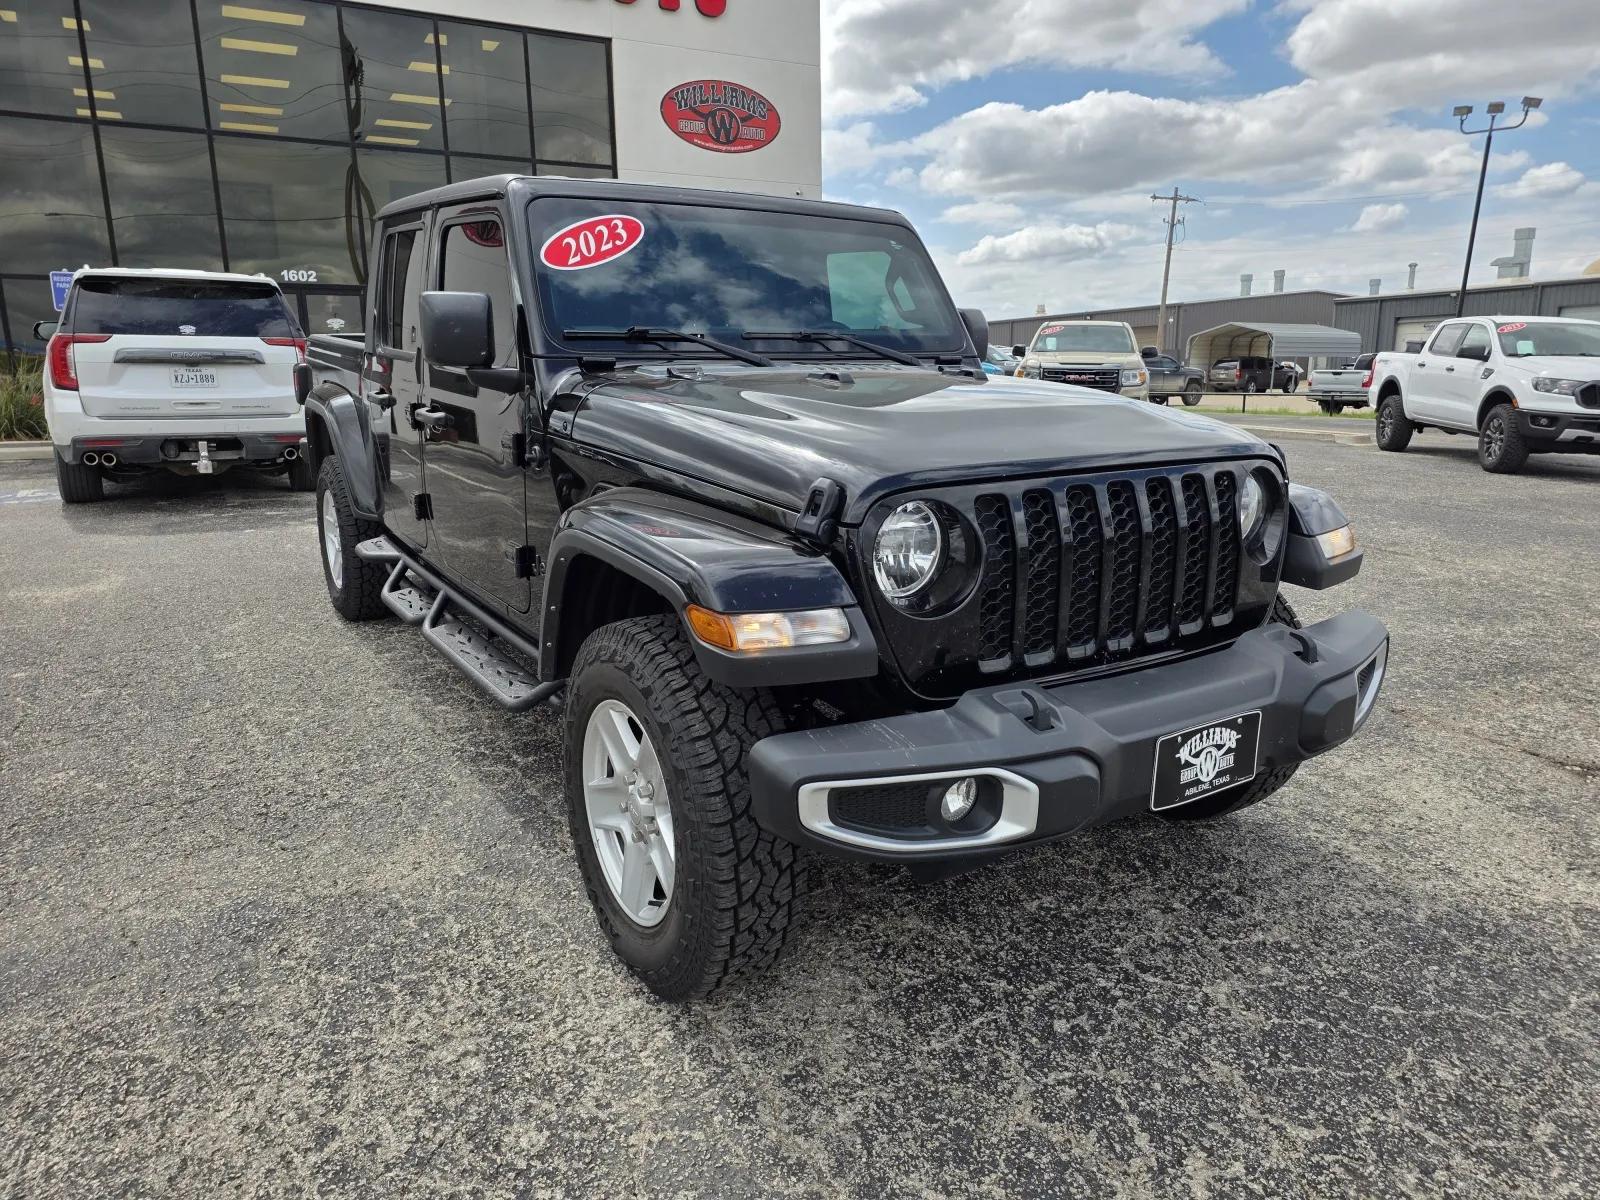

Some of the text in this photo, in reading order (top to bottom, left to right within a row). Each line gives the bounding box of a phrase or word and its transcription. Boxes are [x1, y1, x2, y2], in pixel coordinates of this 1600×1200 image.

[674, 84, 768, 120] WILLIAMS
[680, 120, 766, 140] GROUP AUTO
[562, 219, 628, 265] 2023
[281, 269, 318, 282] 1602
[1065, 374, 1096, 382] GMC
[1179, 727, 1238, 765] WILLIAMS
[1180, 755, 1234, 782] GROUP AUTO
[1184, 782, 1212, 797] ABILENE,
[1212, 774, 1231, 787] TEXAS
